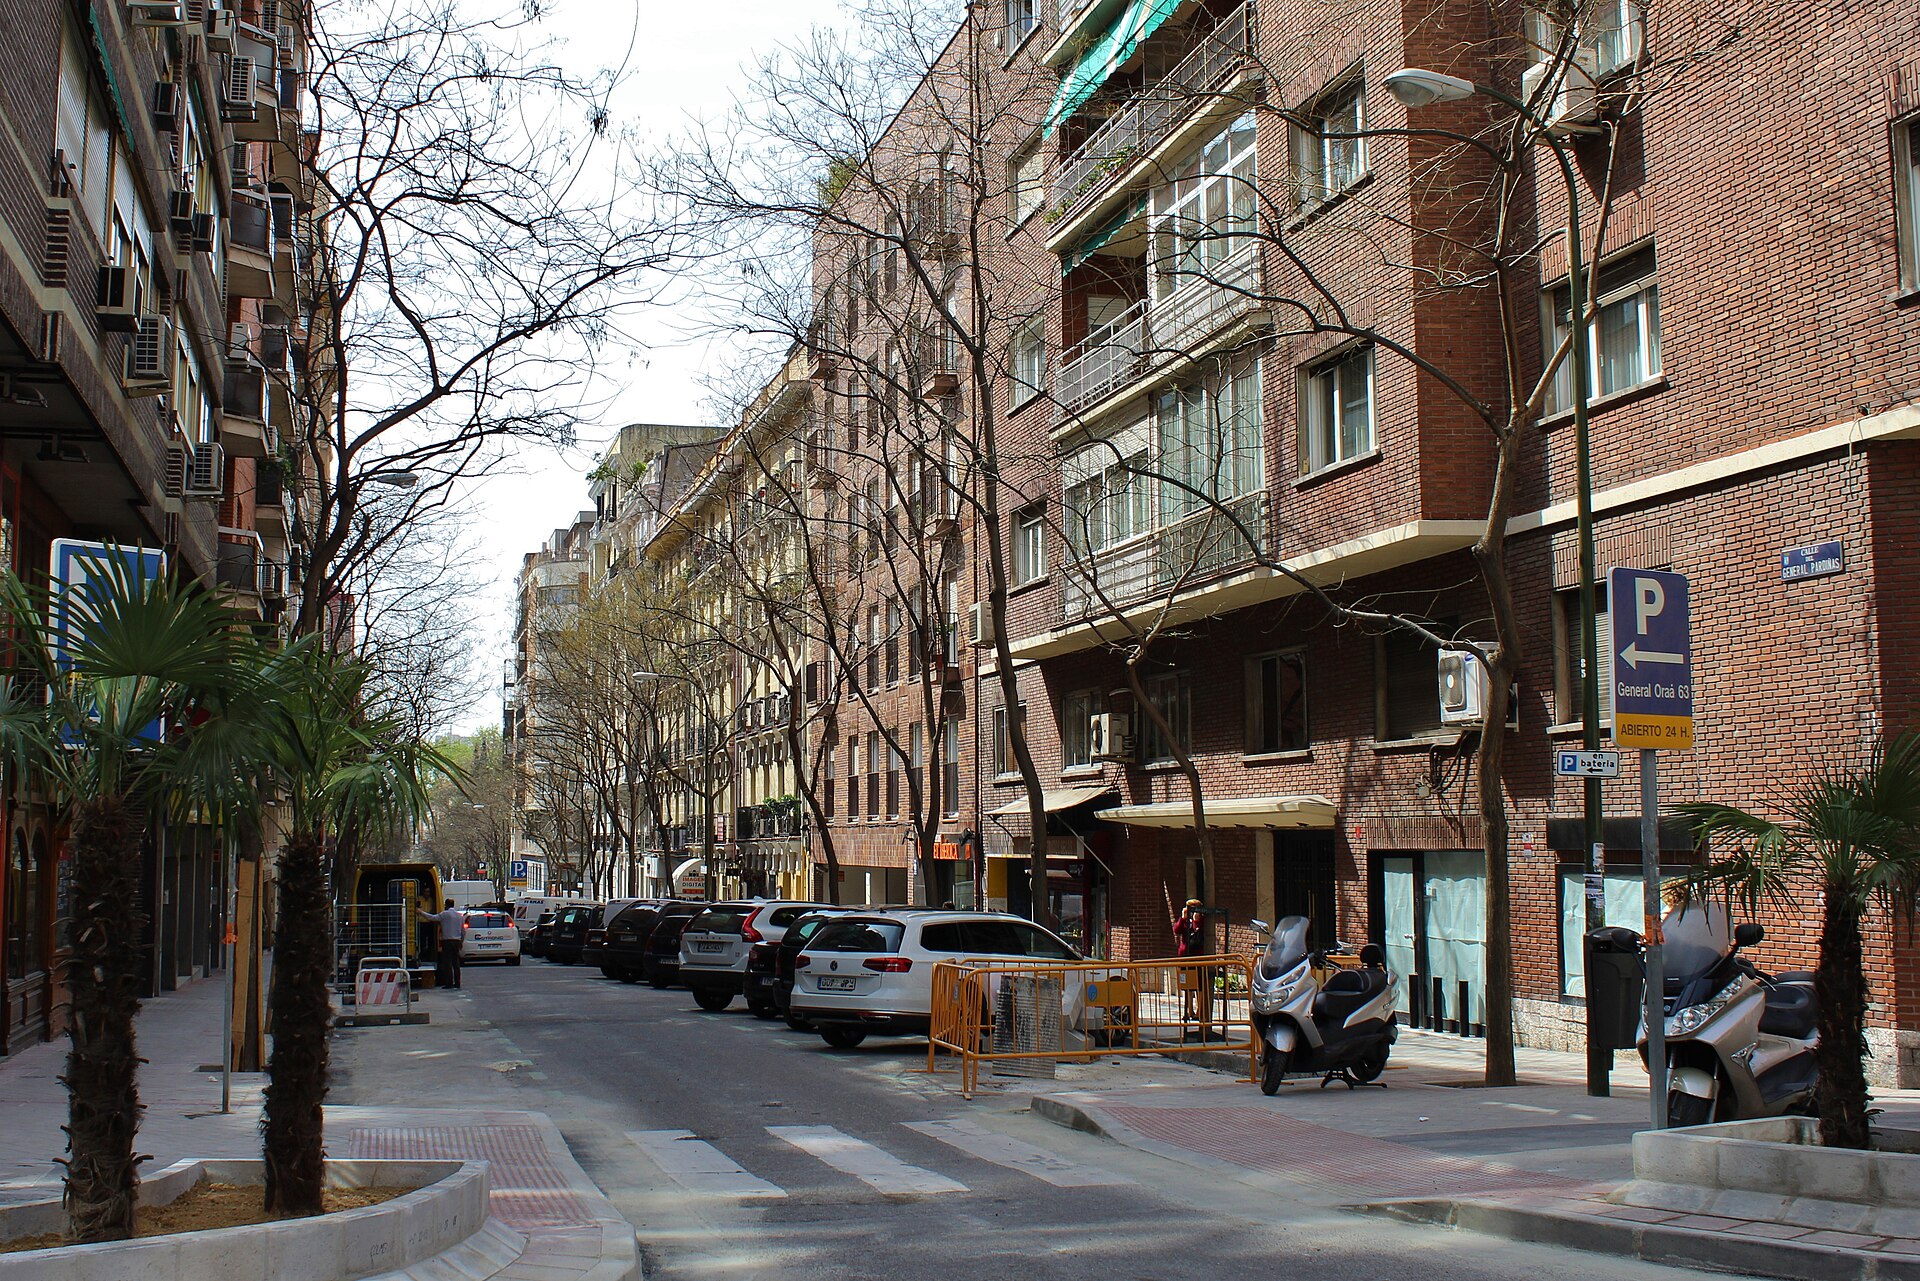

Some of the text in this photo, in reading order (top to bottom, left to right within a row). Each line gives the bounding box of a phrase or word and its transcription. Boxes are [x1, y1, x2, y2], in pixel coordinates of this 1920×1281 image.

[1800, 546, 1819, 556] CALLE
[1782, 557, 1840, 579] GENERAL PARDIÑAS
[1635, 577, 1665, 635] P
[1617, 681, 1652, 698] General
[1677, 684, 1690, 700] 63
[1620, 723, 1690, 739] ABIERTO 24 H.
[1564, 756, 1574, 770] P
[514, 862, 524, 878] P
